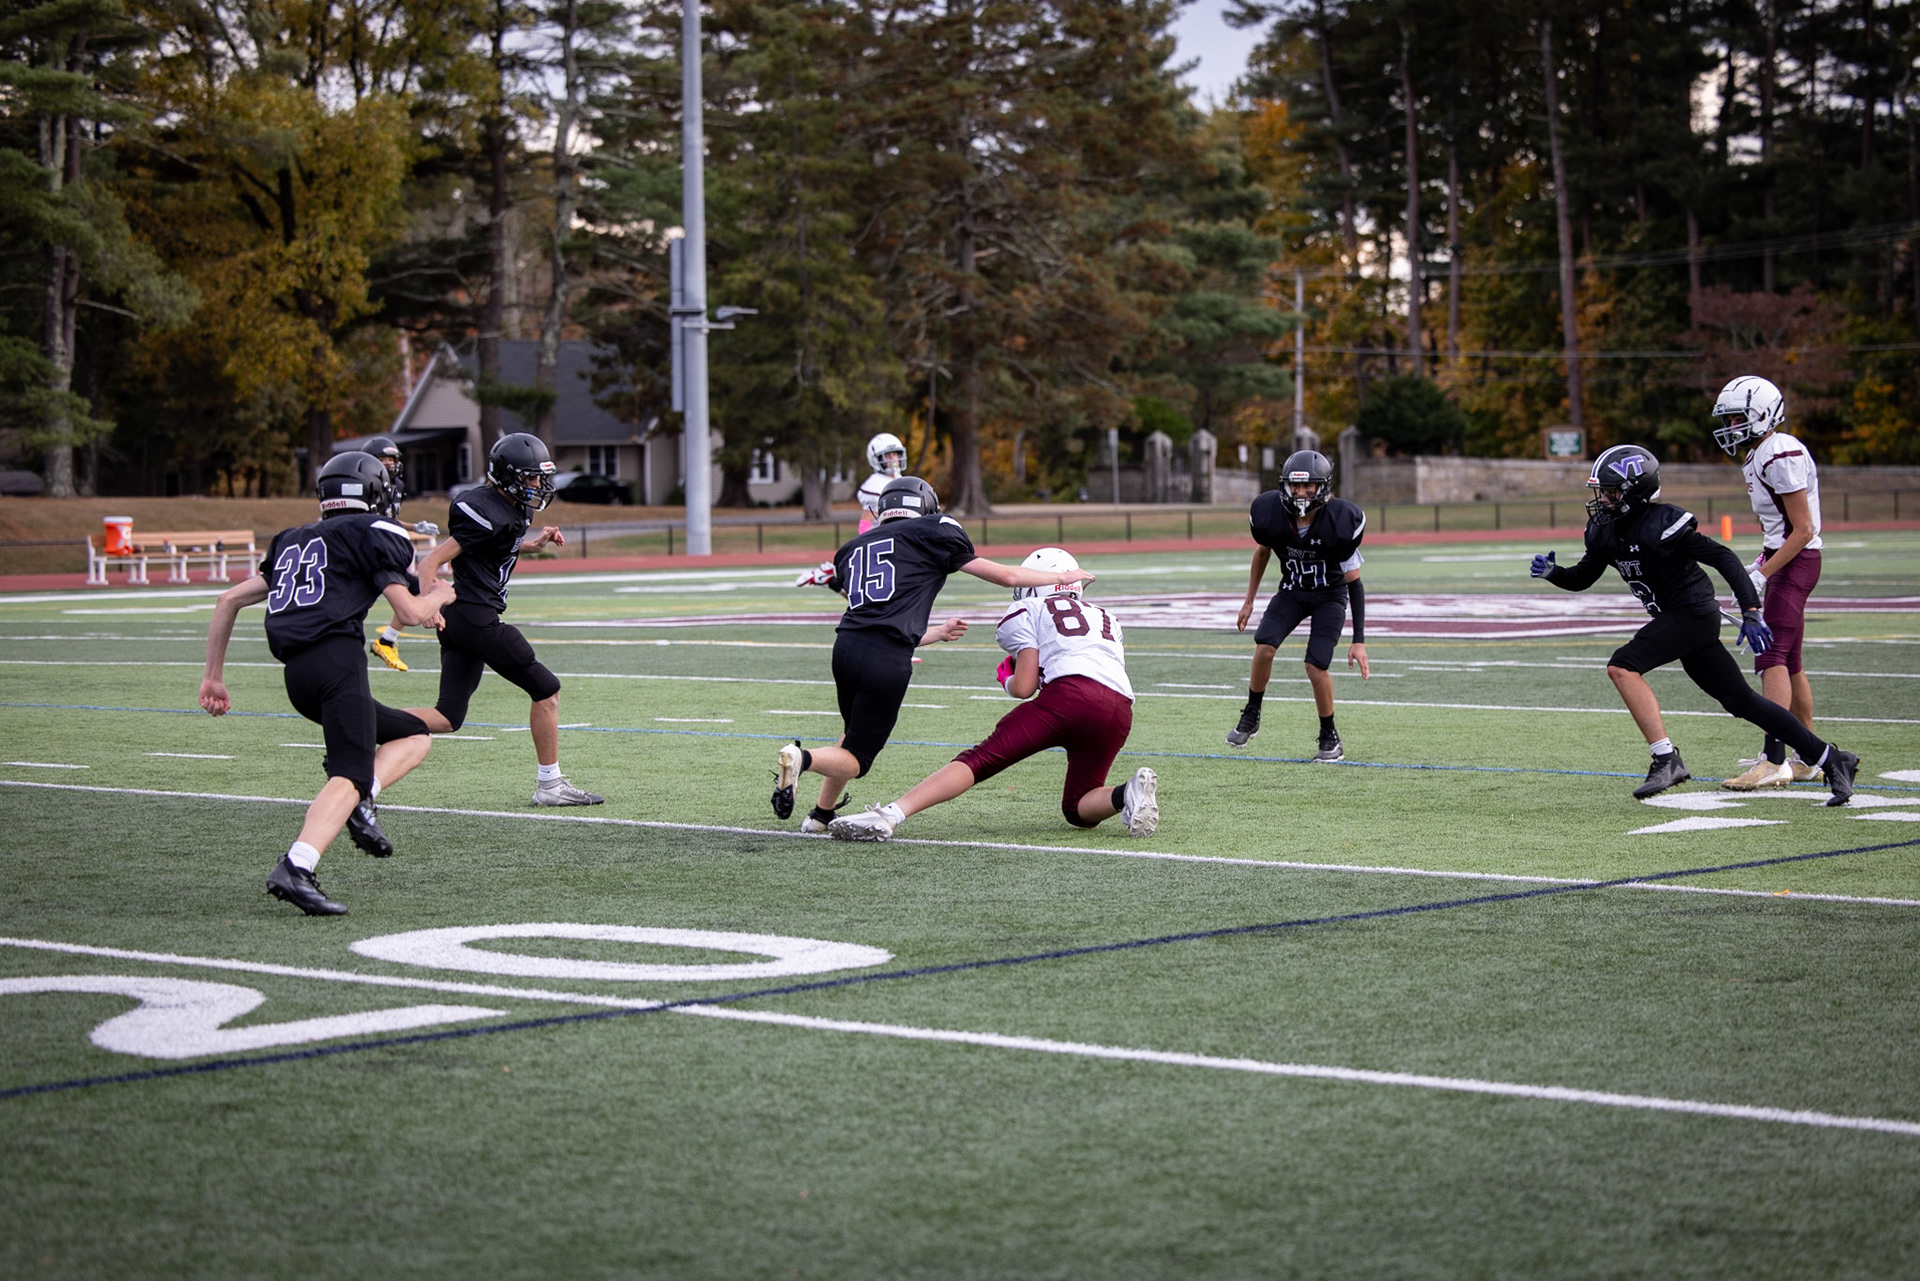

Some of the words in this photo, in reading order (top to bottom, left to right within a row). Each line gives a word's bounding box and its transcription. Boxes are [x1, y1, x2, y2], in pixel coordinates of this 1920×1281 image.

[1608, 454, 1645, 480] VT
[267, 536, 328, 614] 33
[847, 537, 896, 610] 15
[1286, 559, 1330, 589] 17
